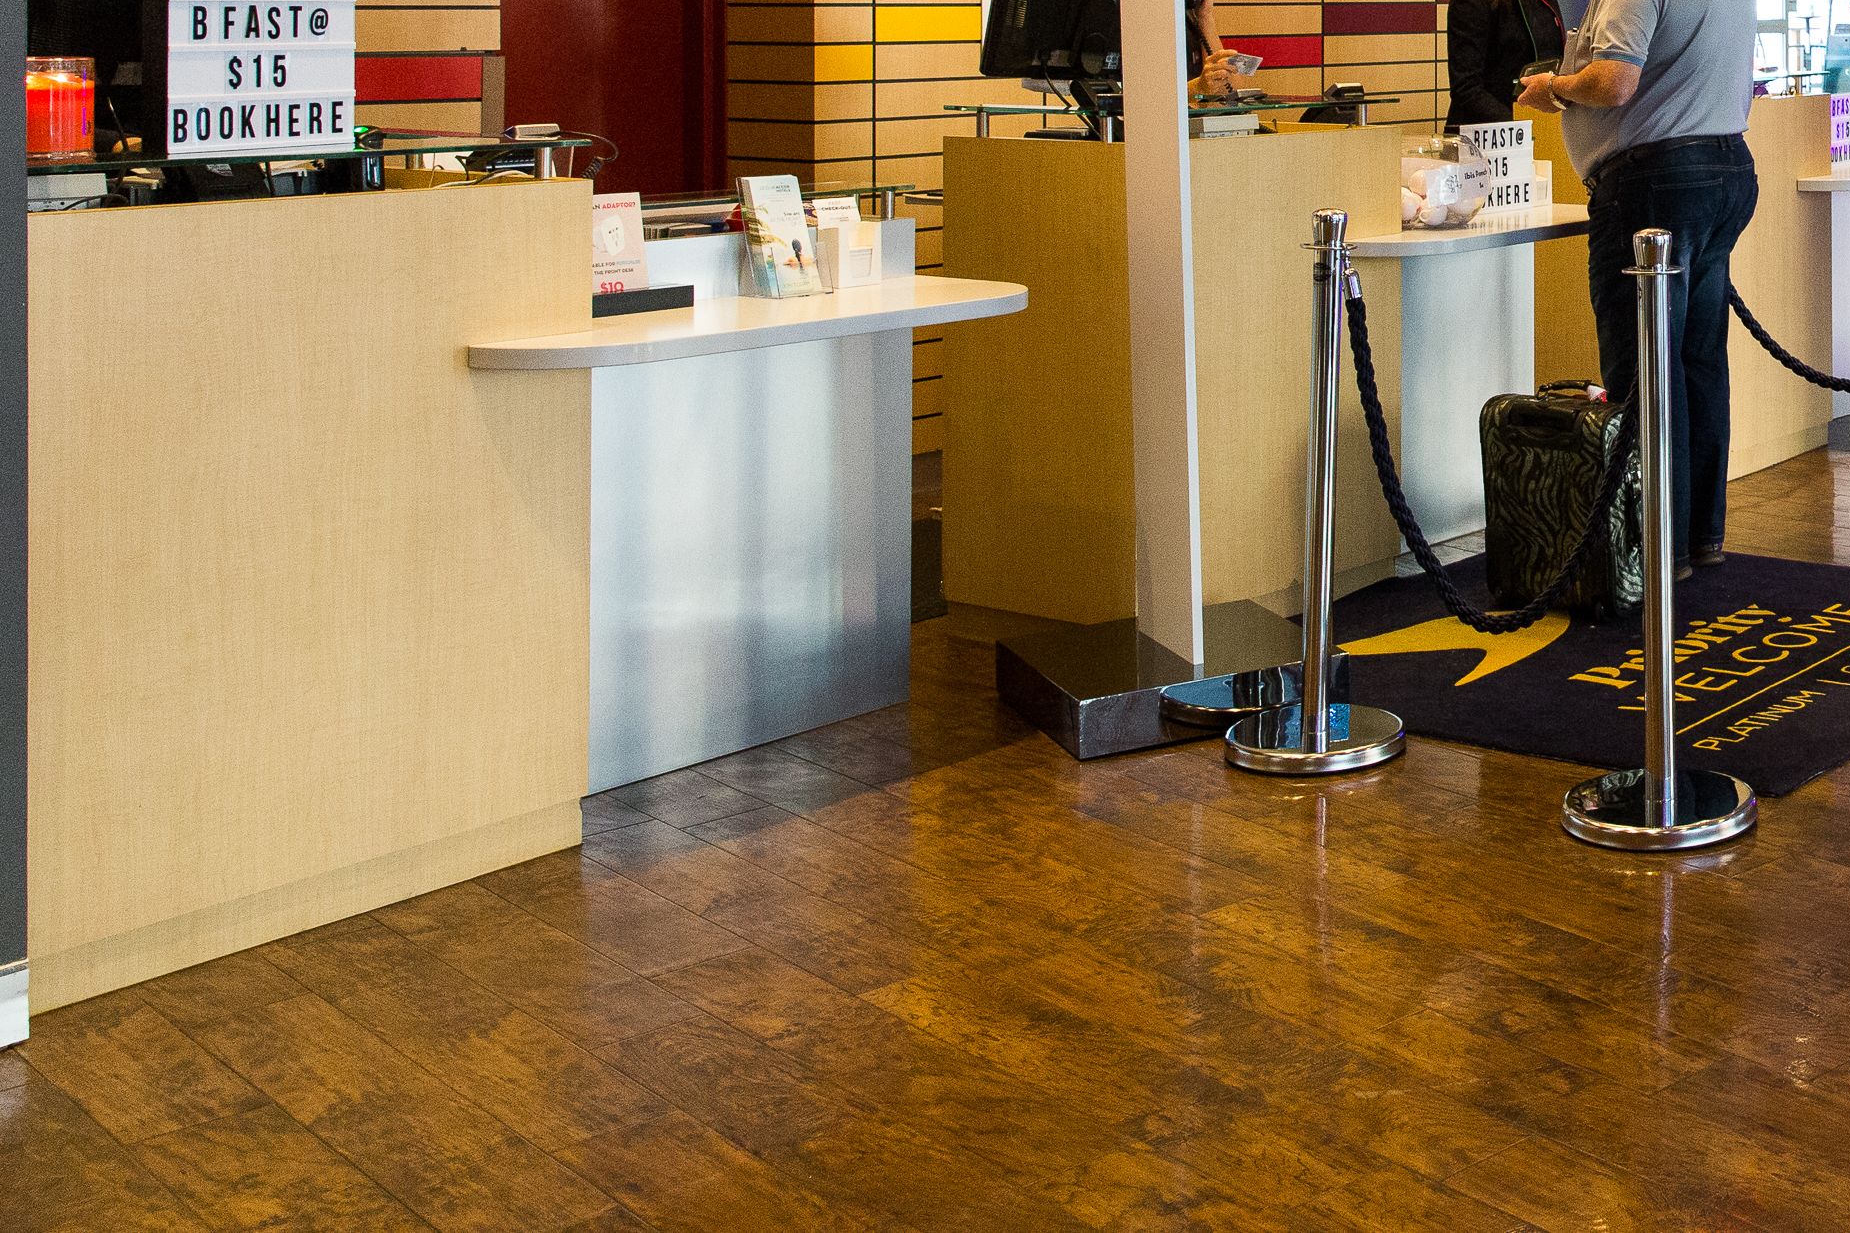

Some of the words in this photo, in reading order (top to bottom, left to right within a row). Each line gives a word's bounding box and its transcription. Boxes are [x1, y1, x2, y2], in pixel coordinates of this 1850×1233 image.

[228, 54, 287, 89] $15
[1837, 122, 1849, 138] $15
[602, 201, 636, 209] ADAPTOR?
[1482, 183, 1530, 208] KHERE
[1692, 689, 1826, 750] PLATINUM
